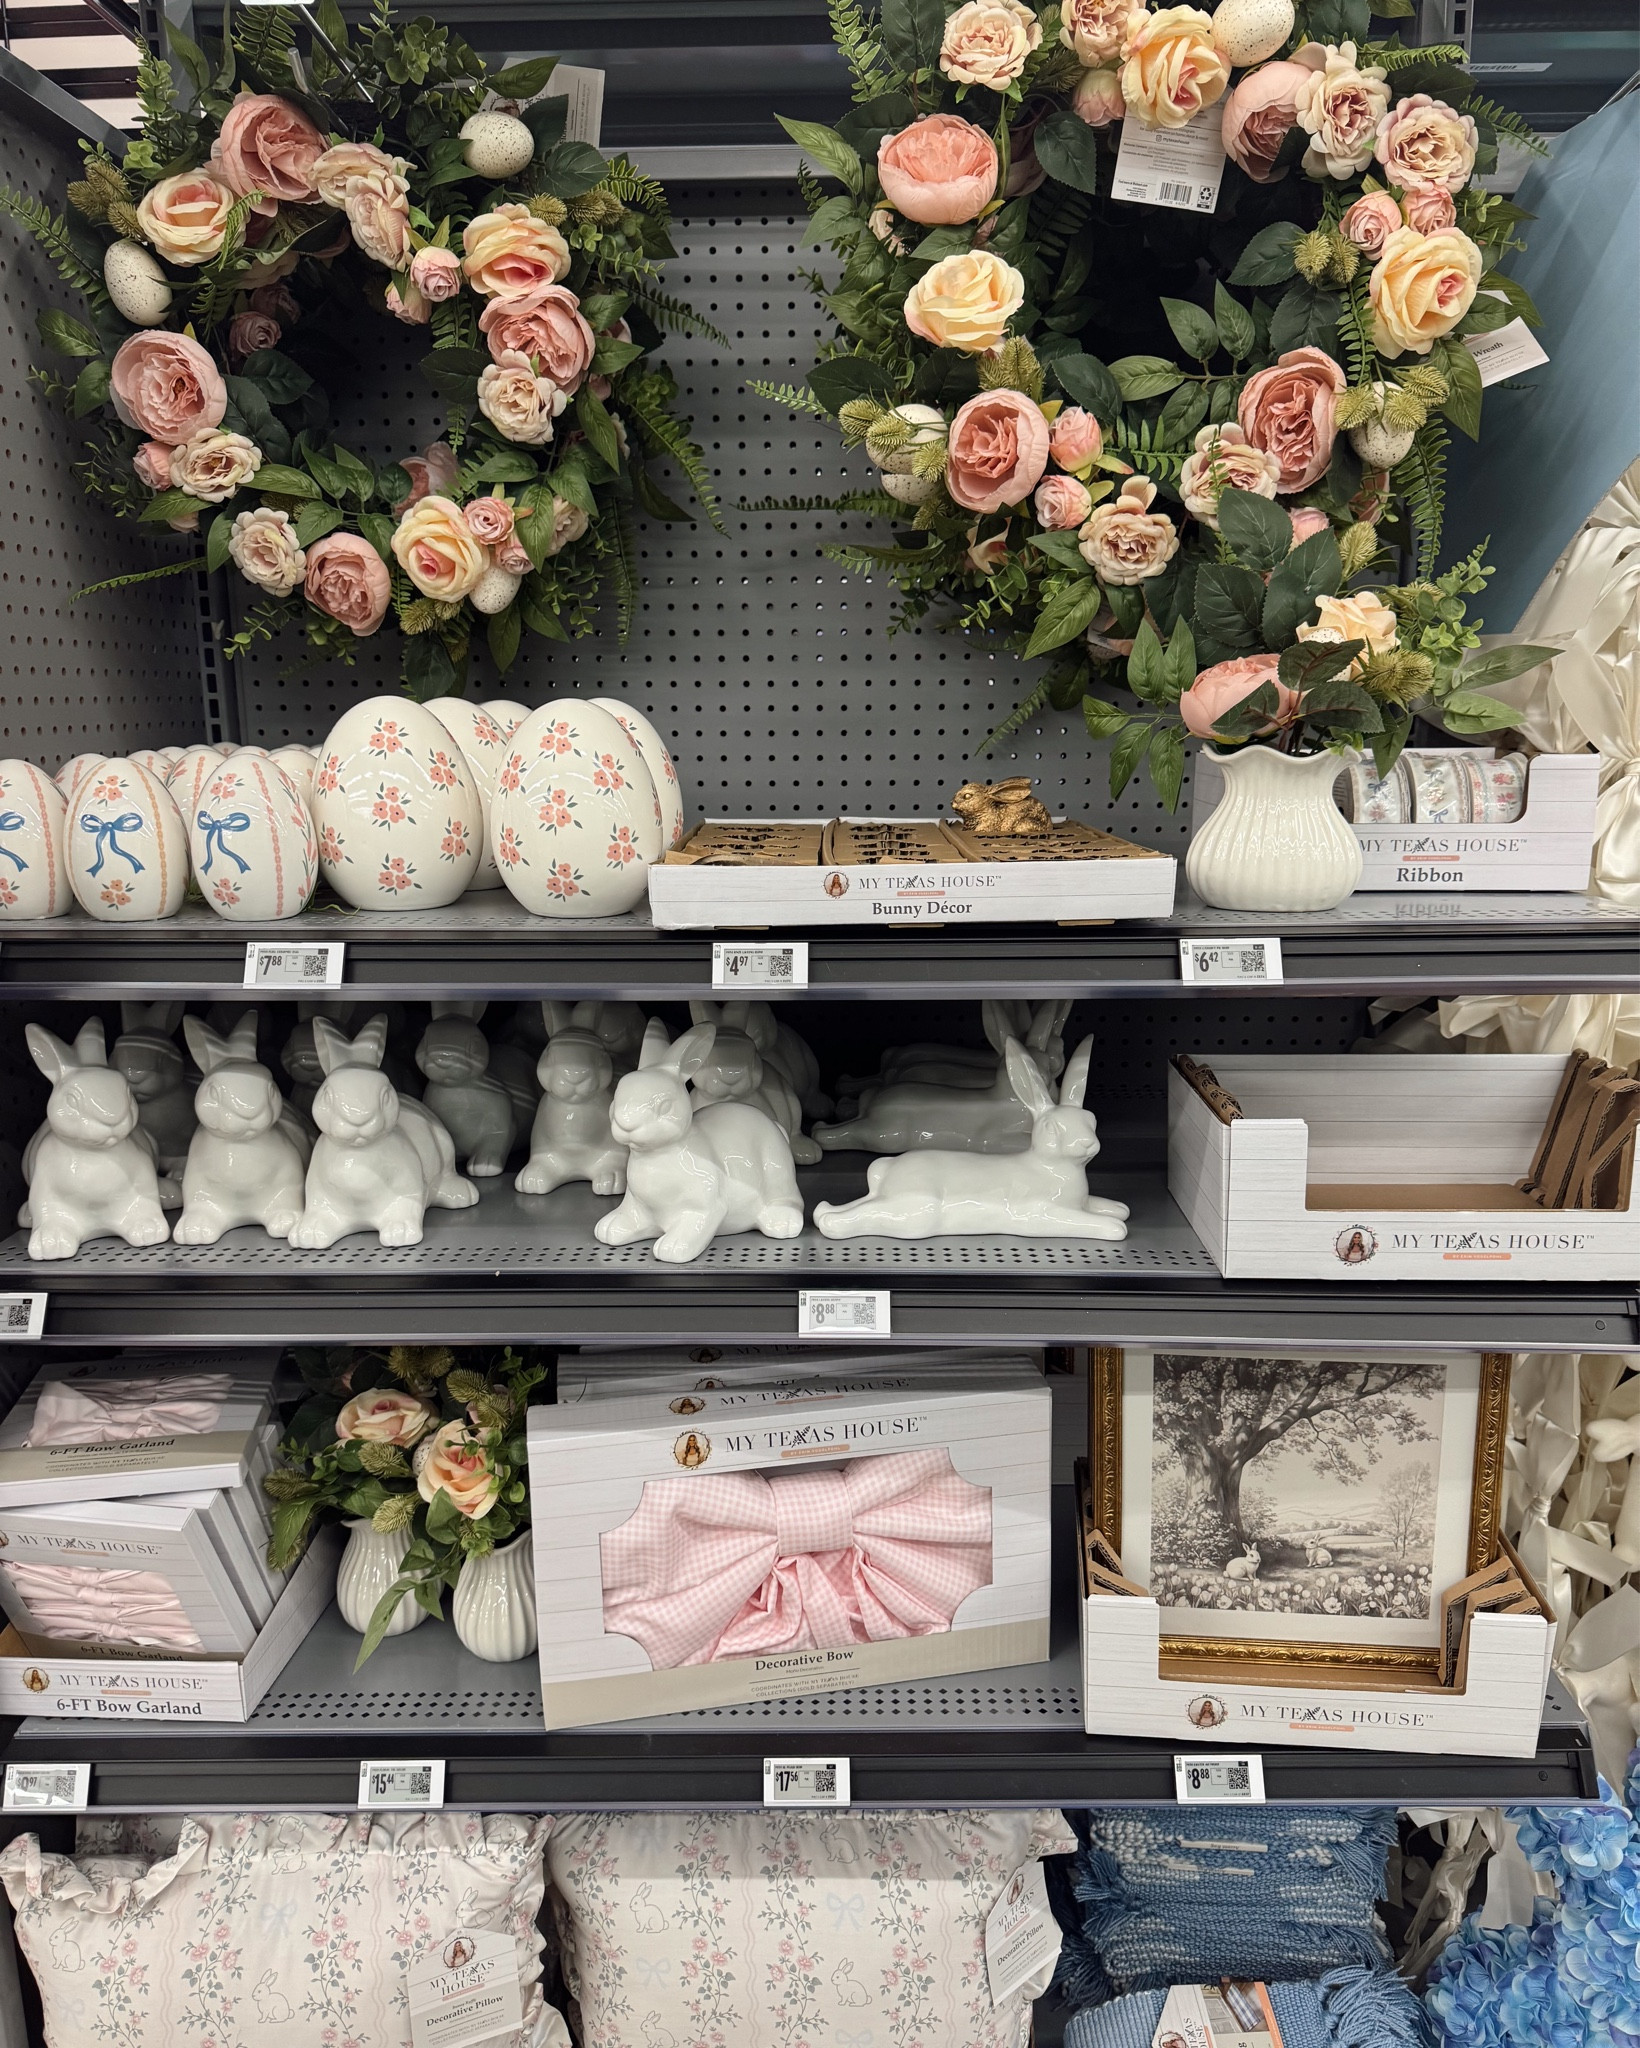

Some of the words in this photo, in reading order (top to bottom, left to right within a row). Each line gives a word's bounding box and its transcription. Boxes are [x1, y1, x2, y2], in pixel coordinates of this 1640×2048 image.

[1472, 342, 1504, 357] Wreath
[1391, 837, 1448, 853] TEXAS
[859, 878, 880, 889] MY
[886, 875, 935, 890] TEXAS
[1396, 868, 1463, 882] Ribbon
[872, 902, 922, 918] Bunny
[928, 902, 972, 914] Décor
[1392, 1234, 1426, 1249] MY
[1430, 1232, 1500, 1250] TEXAS
[720, 1395, 749, 1406] MY
[757, 1386, 826, 1402] TEXAS
[725, 1436, 756, 1453] MY
[764, 1425, 834, 1448] TEXAS
[50, 1446, 84, 1458] 6-FT
[120, 1439, 176, 1450] Garland
[17, 1534, 38, 1545] MY
[44, 1537, 96, 1550] TEXAS
[81, 1646, 106, 1654] 6-FT
[110, 1648, 134, 1657] Bow
[137, 1650, 184, 1661] Garland
[755, 1654, 823, 1671] Decorative
[826, 1651, 854, 1662] Bow
[60, 1675, 81, 1686] MY
[86, 1674, 140, 1688] TEXAS
[56, 1698, 92, 1711] 6-FT
[97, 1700, 131, 1712] Bow
[137, 1700, 202, 1715] Garland
[1240, 1704, 1270, 1718] MY
[1276, 1706, 1343, 1722] TEXAS
[1010, 1889, 1035, 1914] TEXAS
[997, 1938, 1026, 1966] Decorative
[1026, 1922, 1044, 1941] Pillow
[430, 1977, 448, 1990] MY
[452, 1960, 495, 1981] TEXAS
[426, 2006, 474, 2026] Decorative
[476, 1995, 504, 2009] Pillow
